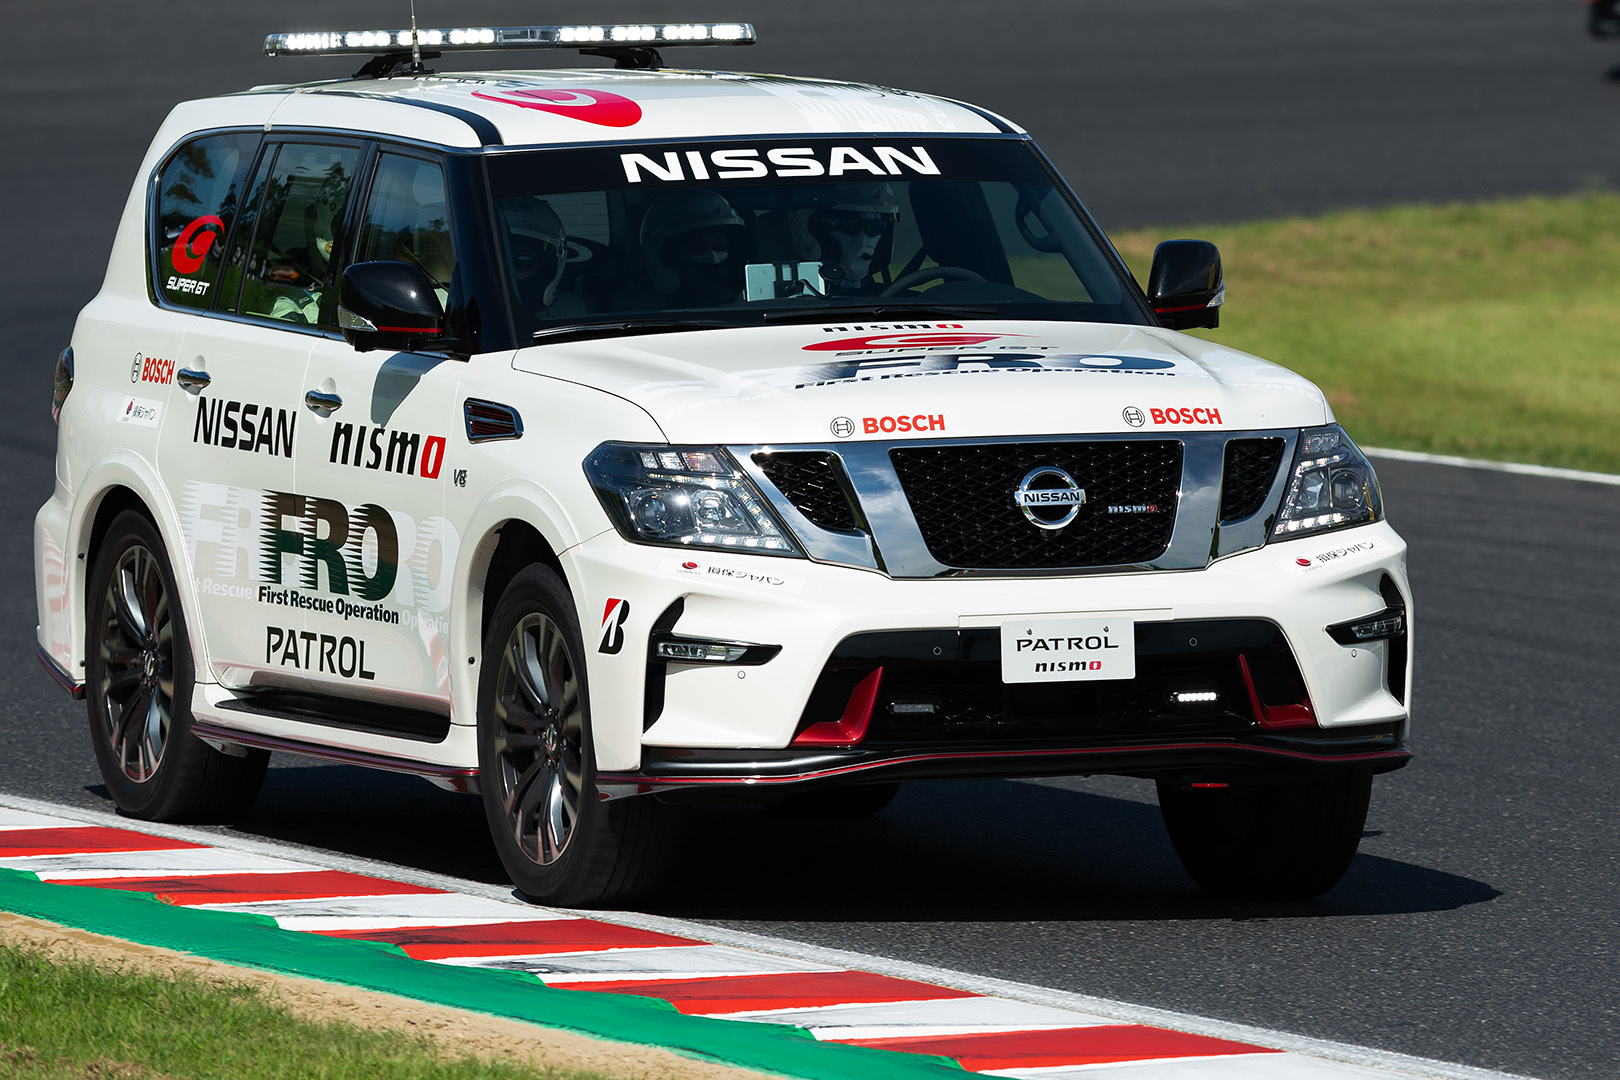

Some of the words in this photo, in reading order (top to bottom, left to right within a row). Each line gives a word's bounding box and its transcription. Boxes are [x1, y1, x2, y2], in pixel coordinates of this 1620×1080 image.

[620, 146, 942, 183] NISSAN
[166, 276, 197, 293] SUPER
[195, 281, 211, 296] GT
[823, 323, 963, 332] nismo
[142, 357, 176, 385] BOSCH
[863, 414, 946, 434] BOSCH
[1149, 407, 1223, 424] BOSCH
[193, 396, 297, 459] NISSAN
[329, 421, 447, 480] nismo
[1024, 491, 1080, 503] NISSAN
[1108, 504, 1157, 513] nismo
[259, 488, 399, 601] FRO
[258, 585, 289, 606] First
[290, 590, 334, 613] Rescue
[335, 597, 400, 624] Operation
[266, 626, 376, 680] PATROL
[1016, 636, 1119, 652] PATROL
[1035, 660, 1102, 673] nismo
